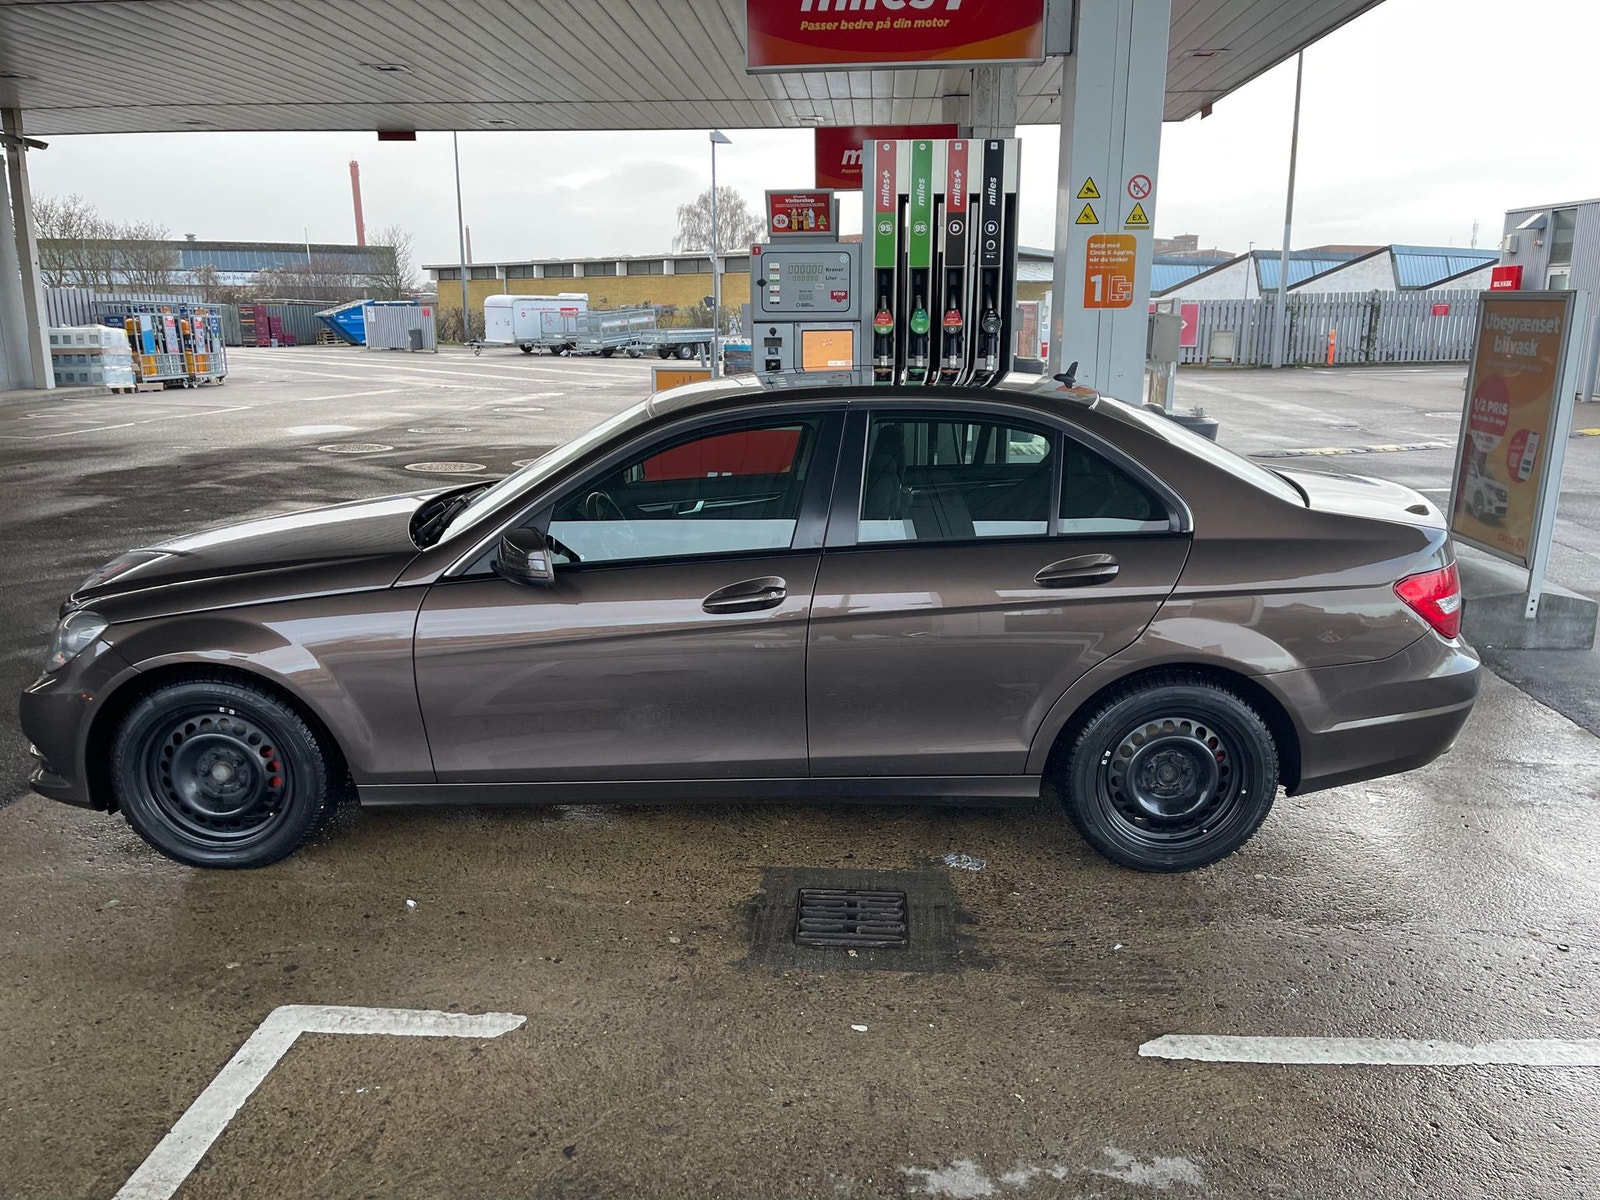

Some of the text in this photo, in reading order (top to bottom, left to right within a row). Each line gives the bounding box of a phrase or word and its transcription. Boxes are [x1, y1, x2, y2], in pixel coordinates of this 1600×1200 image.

[800, 17, 950, 31] Passer bedre på din motor
[882, 169, 891, 207] miles+
[917, 177, 926, 207] miles
[953, 169, 962, 207] miles+
[989, 176, 997, 206] miles
[1132, 213, 1143, 221] EX
[880, 223, 891, 232] 95
[914, 223, 926, 232] 95
[952, 223, 959, 232] D
[987, 223, 995, 232] D
[1090, 274, 1103, 302] 1
[1485, 312, 1561, 335] Ubegrænset
[1493, 335, 1539, 357] bilvask
[1474, 397, 1509, 415] 1/2 PRIS
